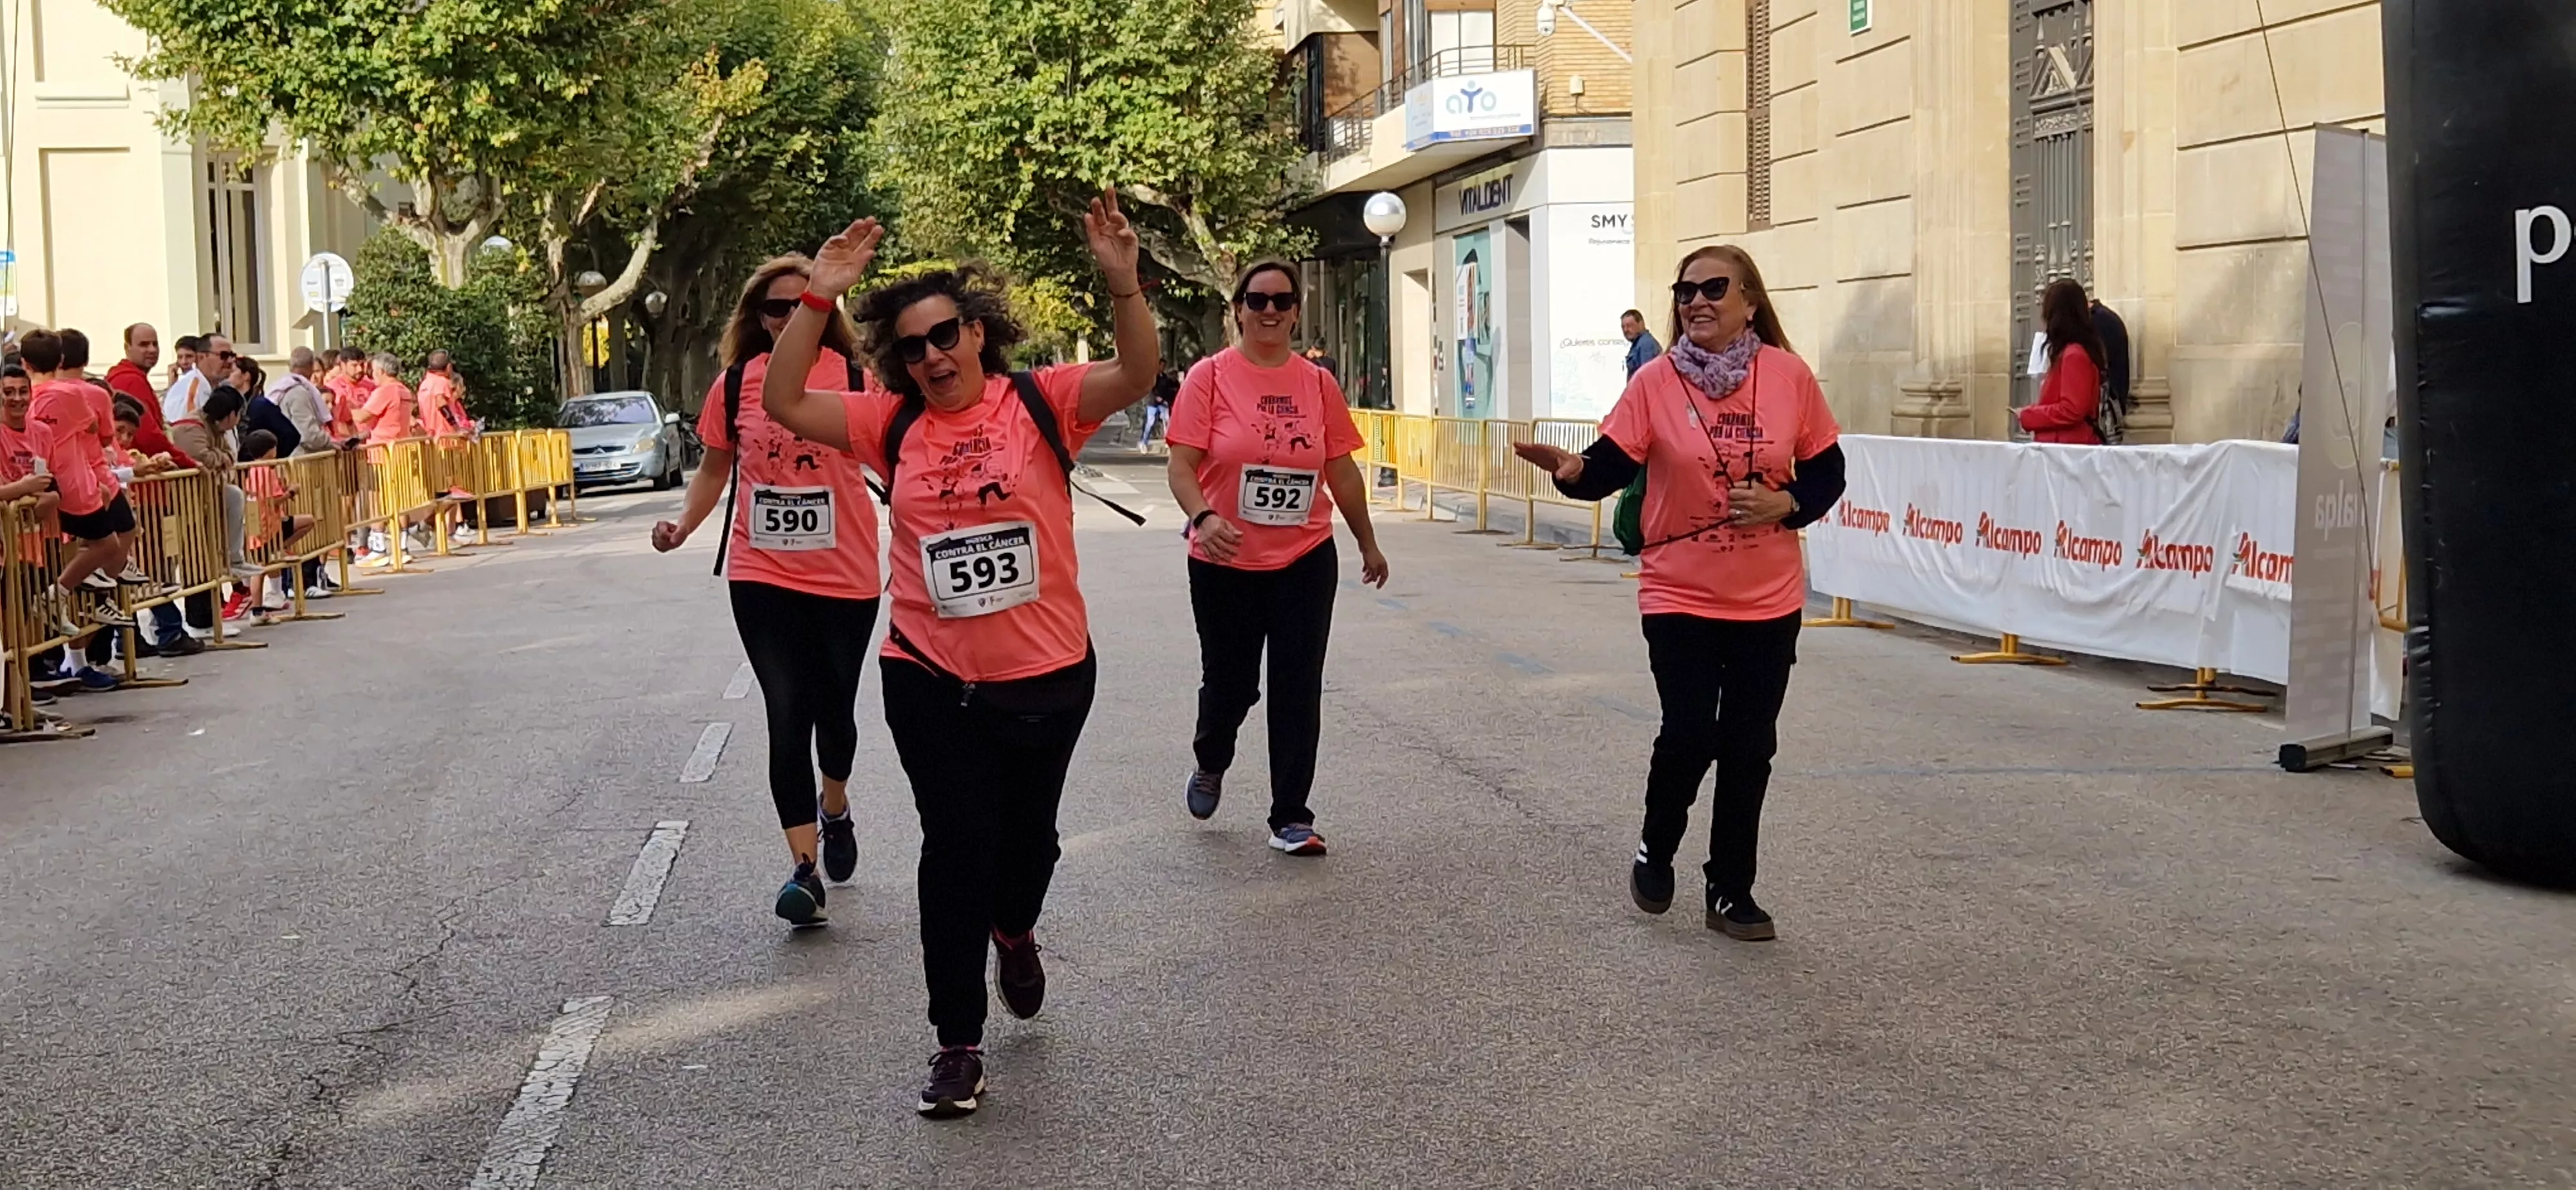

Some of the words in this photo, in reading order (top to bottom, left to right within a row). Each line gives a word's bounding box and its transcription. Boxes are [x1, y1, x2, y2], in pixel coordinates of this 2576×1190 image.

[1459, 173, 1513, 216] VITALDENT
[1591, 214, 1628, 229] SMY
[2515, 205, 2576, 303] p
[1725, 426, 1733, 439] LA
[1255, 486, 1300, 509] 592
[765, 508, 818, 532] 590
[1902, 502, 1963, 549] Alcampo
[1975, 511, 2042, 560] Alcampo
[935, 545, 974, 559] CONTRA
[976, 543, 988, 552] EL
[989, 536, 1025, 550] CÁNCER
[2054, 520, 2123, 572] Alcampo
[2136, 528, 2213, 579] Alcampo
[950, 552, 1019, 592] 593
